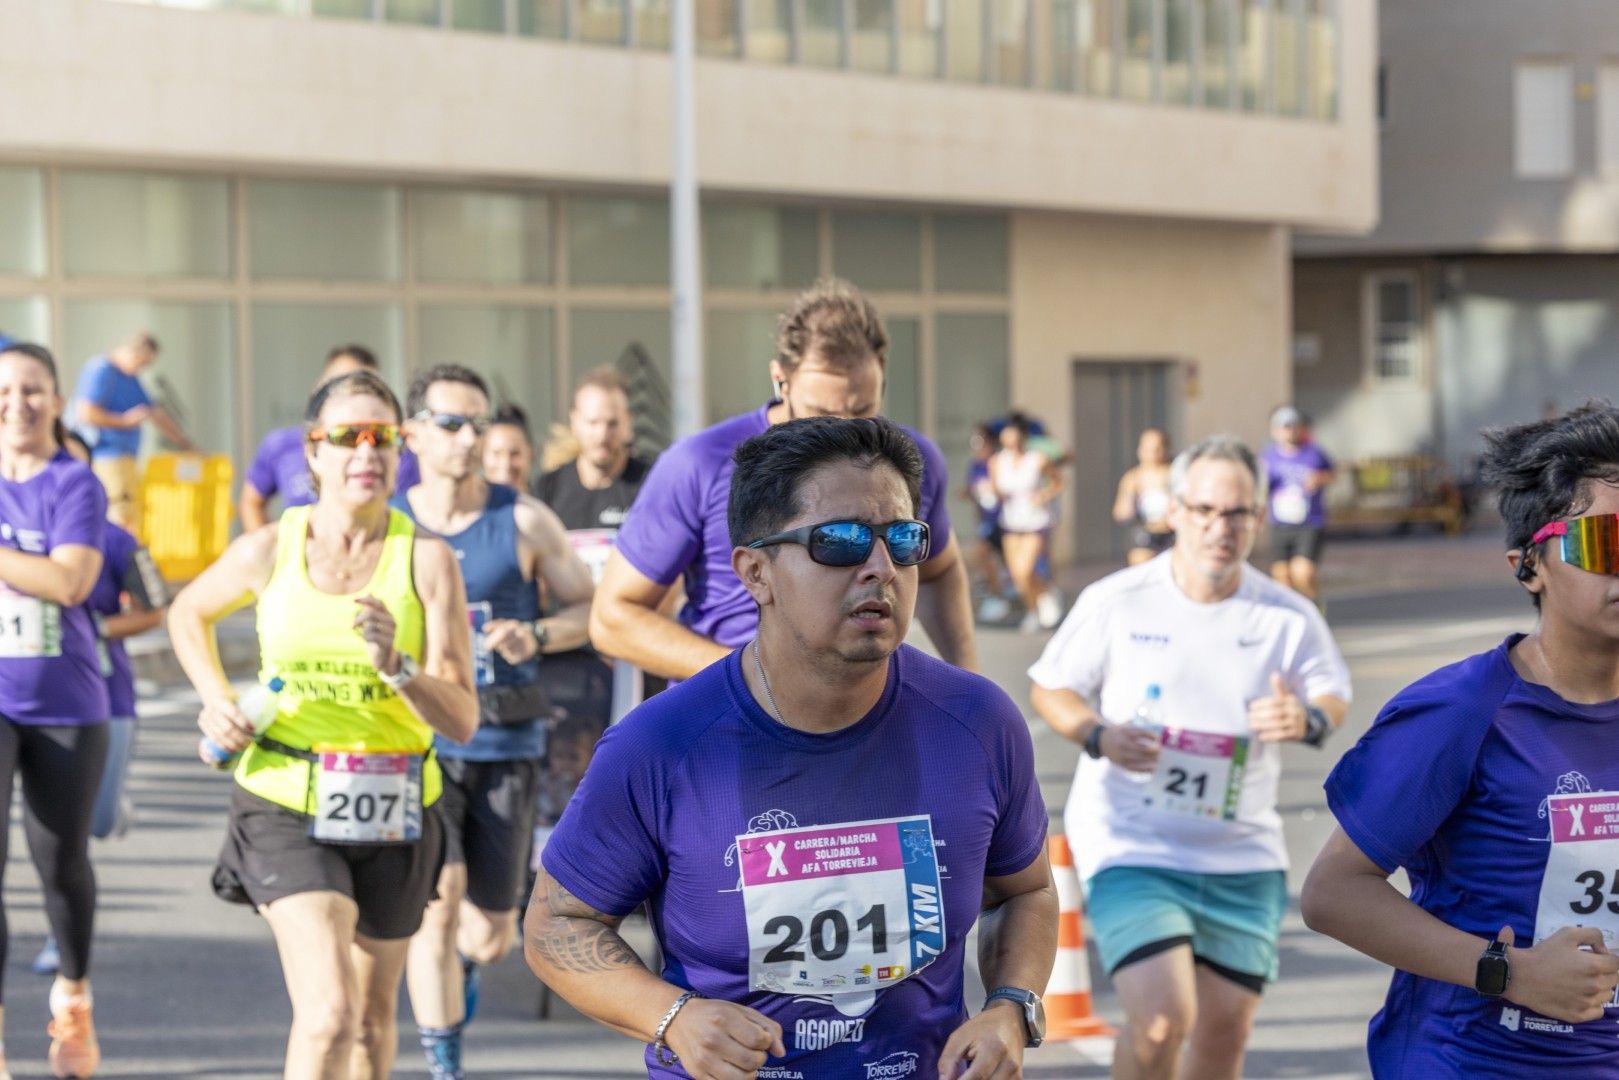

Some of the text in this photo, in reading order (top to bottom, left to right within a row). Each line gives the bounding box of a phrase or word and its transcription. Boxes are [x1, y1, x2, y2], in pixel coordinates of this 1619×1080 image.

[1165, 766, 1208, 799] 21
[327, 792, 399, 823] 207
[1569, 803, 1586, 837] X
[794, 832, 878, 850] CARRERA/MARCHA
[815, 846, 861, 860] SOLIDARIA
[765, 840, 789, 878] X
[801, 856, 878, 874] AFA TORREVIEJA
[763, 903, 889, 964] 201
[911, 882, 941, 959] 7 KM
[794, 1018, 866, 1051] AGAMED
[1523, 1020, 1574, 1034] TORREVIEJA
[754, 1070, 804, 1080] ORREVIEJA
